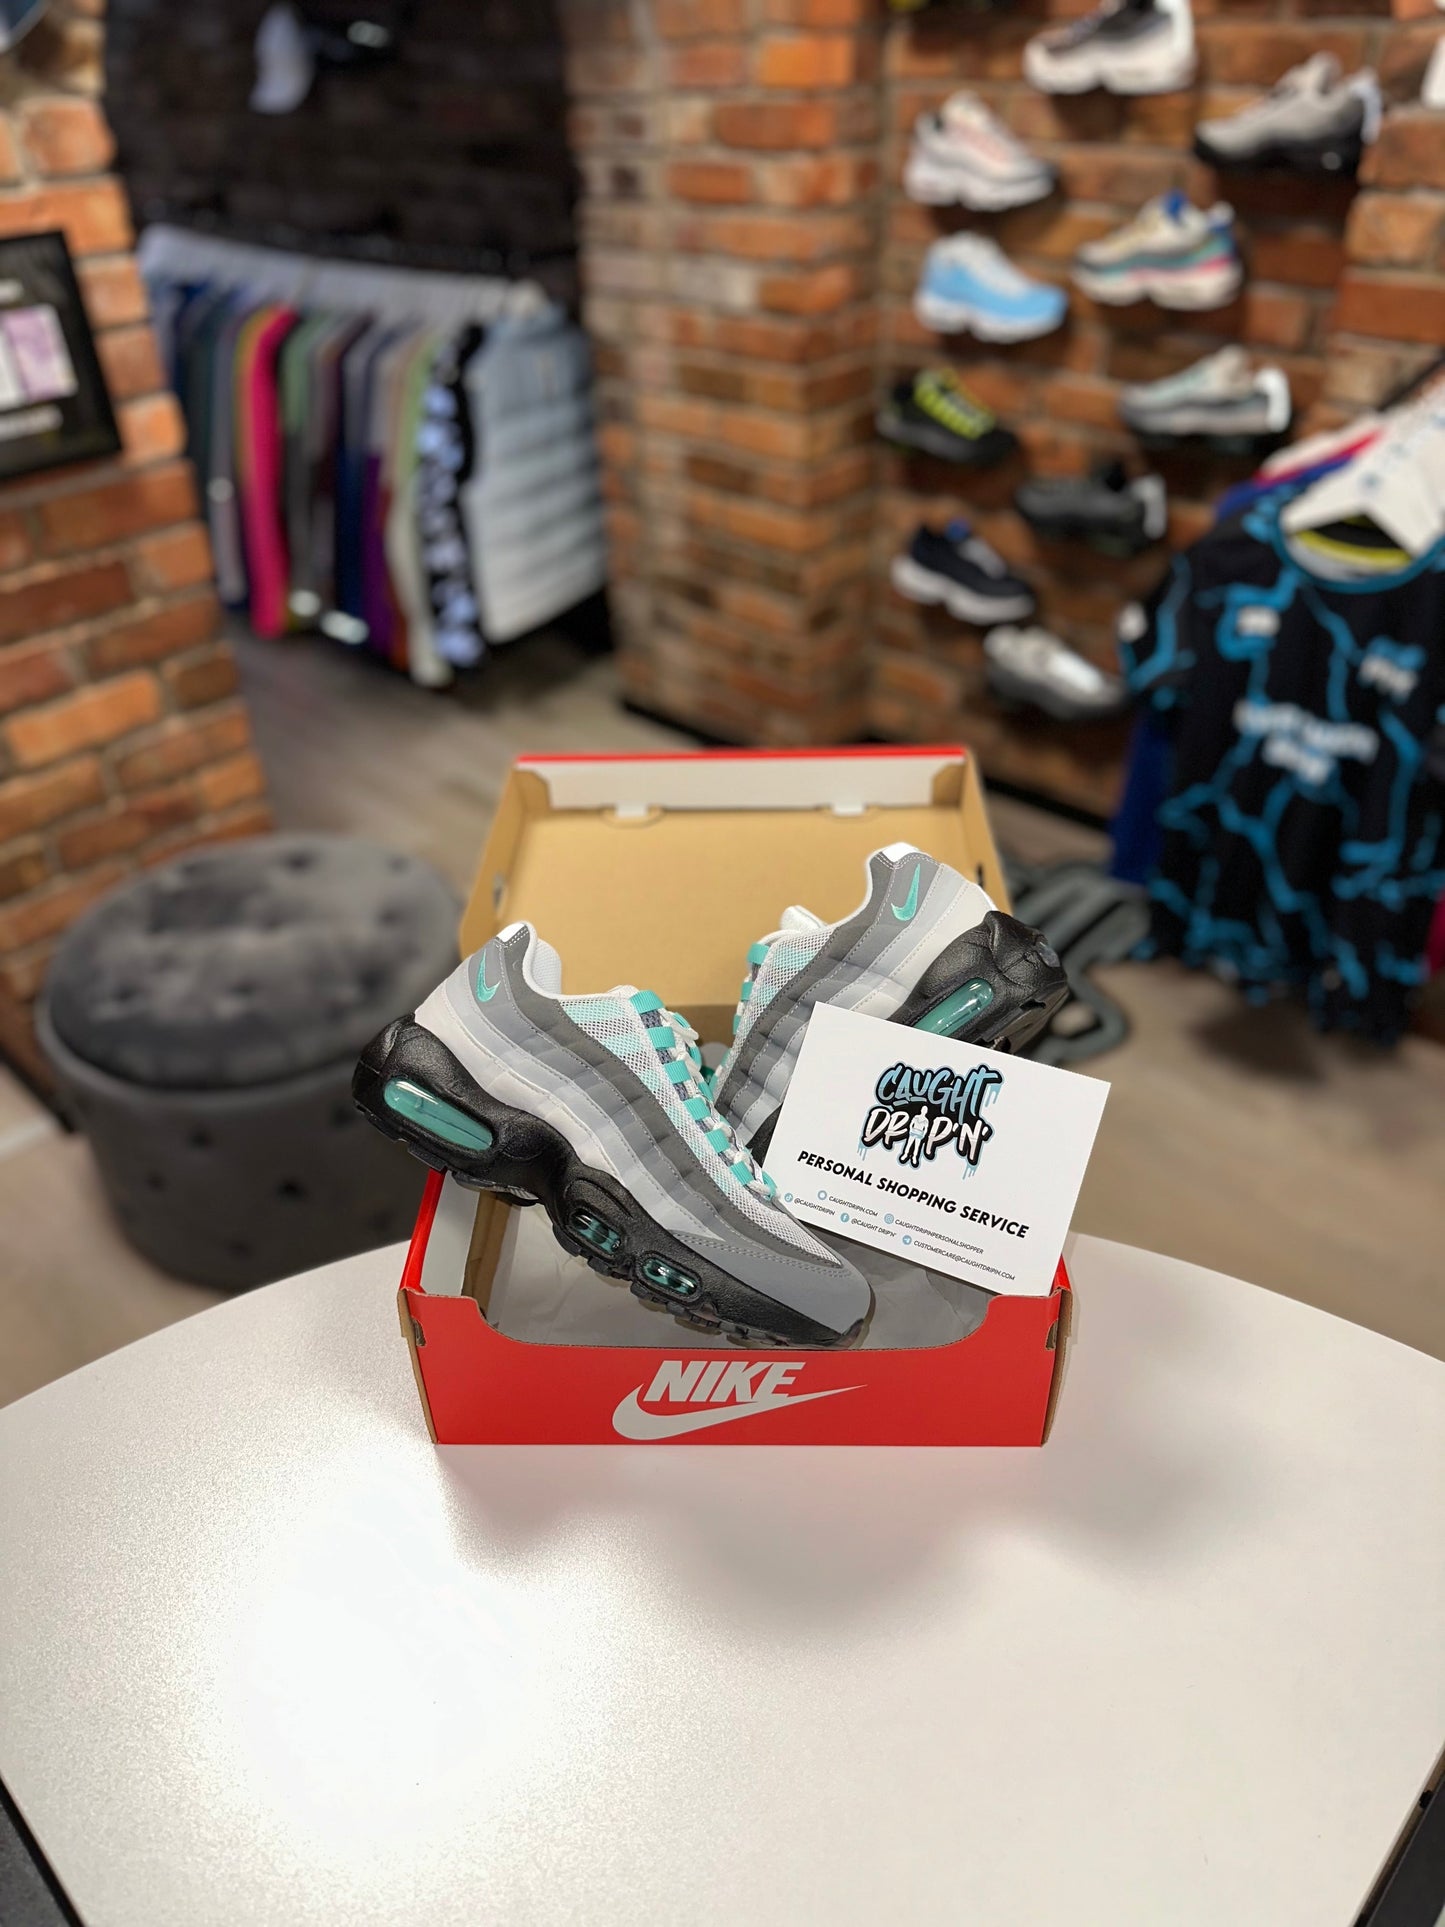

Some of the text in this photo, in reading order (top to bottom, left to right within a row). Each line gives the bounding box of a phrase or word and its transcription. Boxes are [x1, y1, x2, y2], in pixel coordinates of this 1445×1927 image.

[876, 1063, 1003, 1124] CAUGHT
[794, 1197, 836, 1216] @CAUGHTDRIPIN
[797, 1151, 1030, 1239] PERSONAL SHOPPING SERVICE
[829, 1195, 878, 1217] CAUGHTDRIPIN.COM
[851, 1218, 878, 1231] @CAUGHT
[643, 1360, 806, 1402] NIKE
